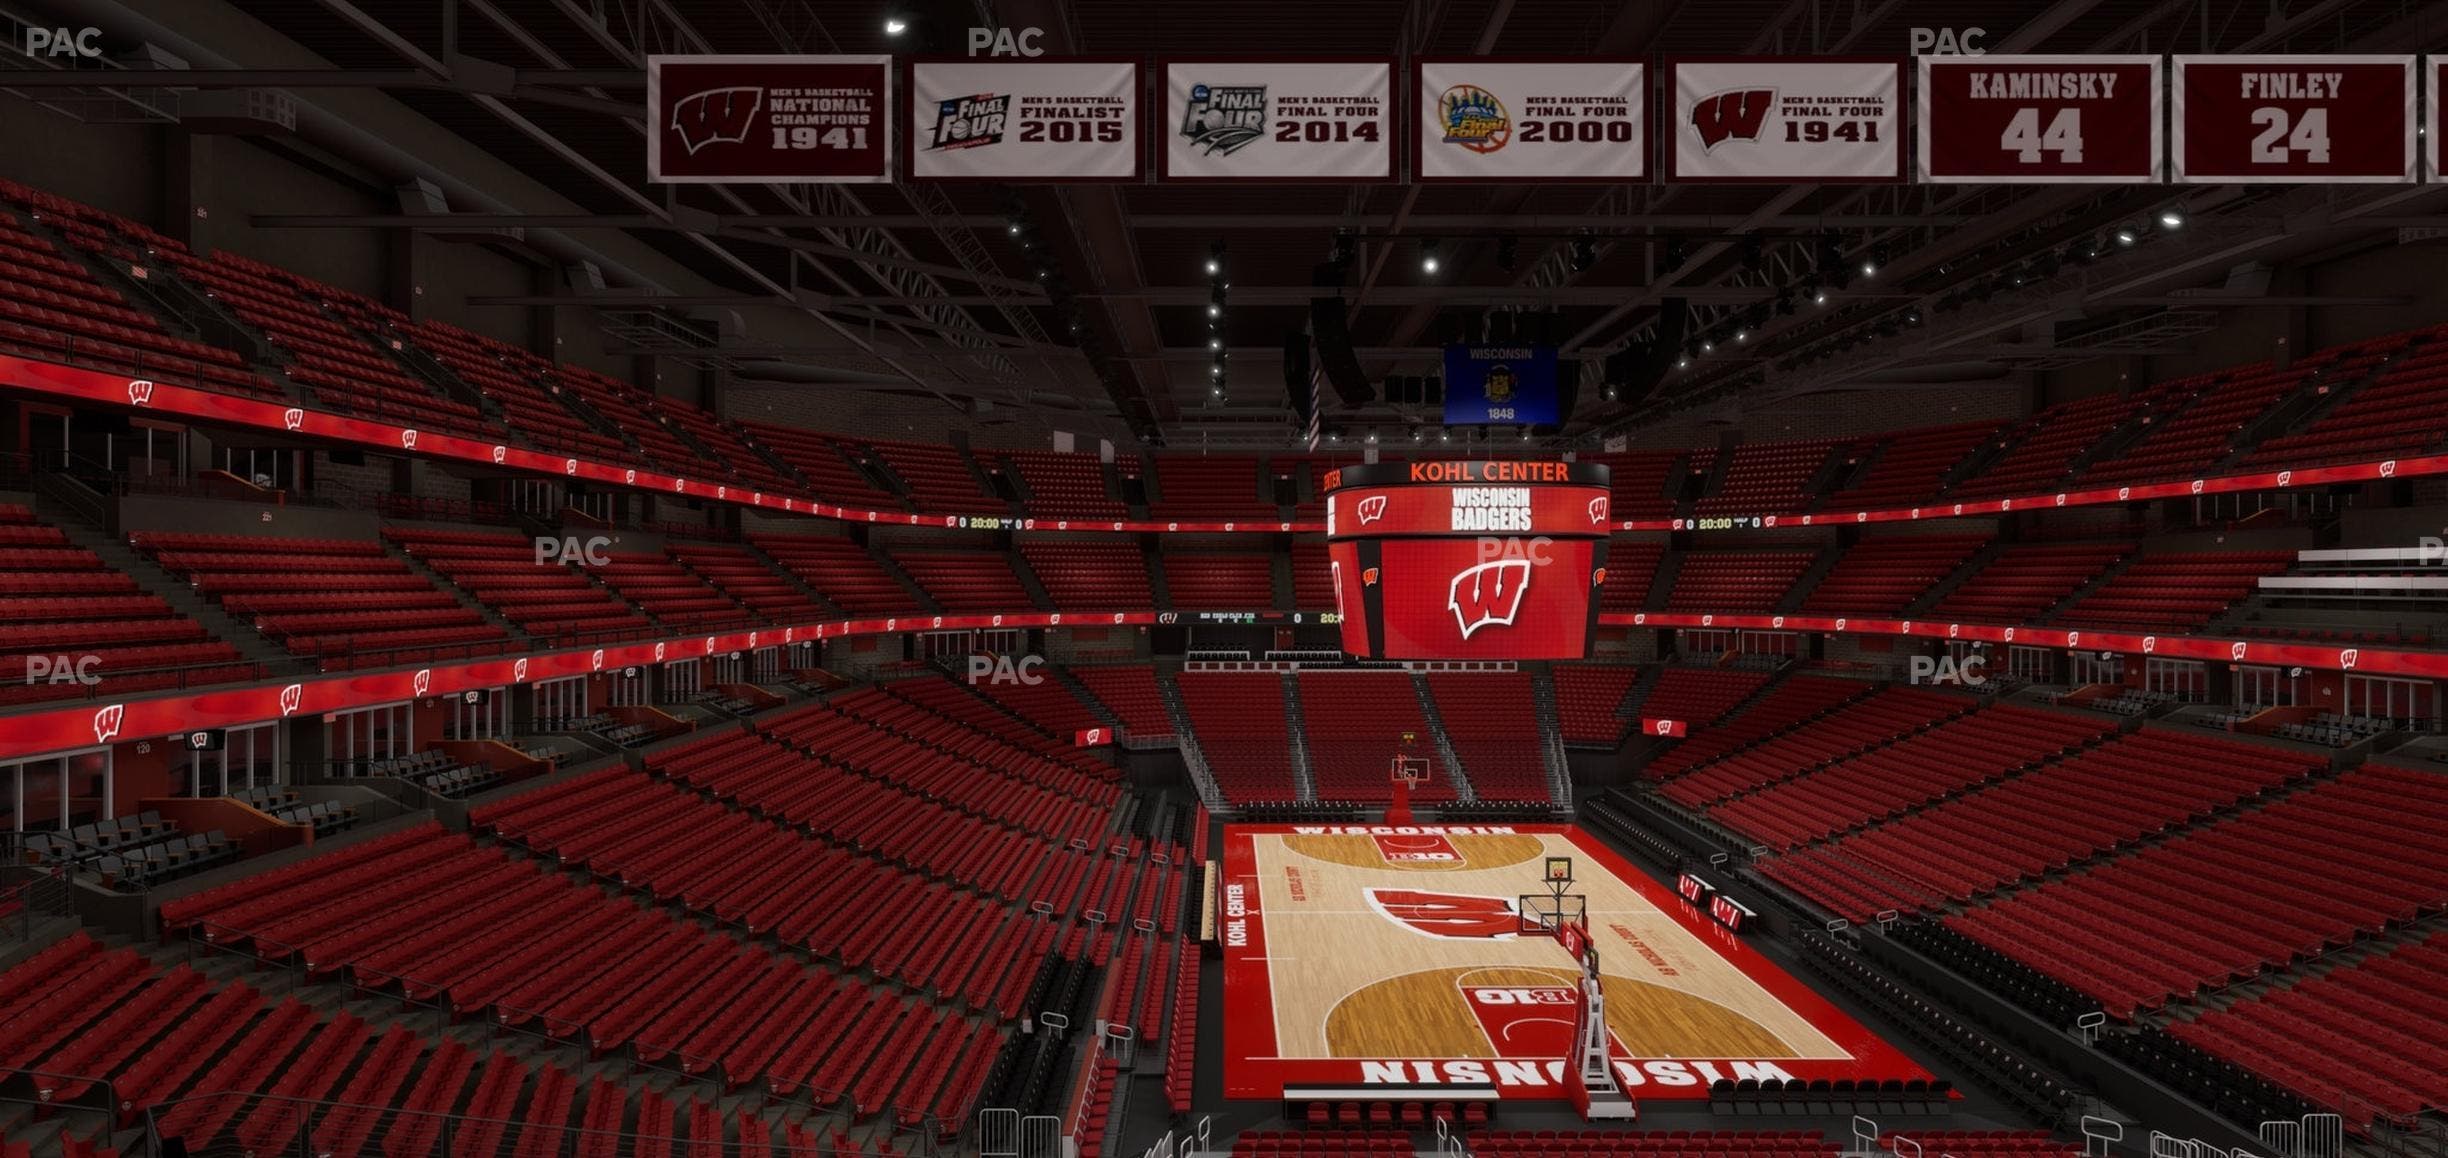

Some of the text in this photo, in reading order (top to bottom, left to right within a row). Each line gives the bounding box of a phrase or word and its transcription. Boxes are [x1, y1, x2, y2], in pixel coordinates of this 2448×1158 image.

[807, 89, 874, 97] BASKETBALL
[1969, 72, 2118, 100] KAMINSKY
[2240, 73, 2344, 100] FINLEY
[770, 98, 872, 113] NATIONAL
[1057, 97, 1124, 105] BASKETBALL
[1207, 88, 1263, 109] FINAL
[1312, 97, 1381, 105] BASKETBALL
[1560, 97, 1628, 105] BASKETBALL
[958, 98, 1004, 120] FINAL
[1021, 107, 1126, 118] FINALIST
[1277, 107, 1379, 118] FINAL FOUR
[1525, 107, 1627, 118] FINAL FOUR
[1782, 107, 1884, 117] FINAL FOUR
[770, 114, 871, 127] CHAMPIONS
[772, 127, 868, 150] 1941
[1020, 121, 1122, 143] 2015
[1275, 121, 1379, 143] 2014
[1519, 121, 1632, 143] 2000
[1785, 120, 1879, 143] 1941
[2001, 107, 2084, 164] 44
[2250, 107, 2330, 164] 24
[1470, 348, 1533, 360] WISCONSIN
[1487, 407, 1515, 420] 1848
[1410, 462, 1569, 482] KOHL CENTER
[1452, 487, 1531, 507] WISCONSIN
[959, 517, 966, 528] 0
[970, 517, 999, 529] 20:00
[1015, 519, 1022, 530] 0
[1451, 507, 1532, 531] BADGERS
[1686, 519, 1694, 530] 0
[1699, 518, 1732, 530] 20:00
[1752, 517, 1760, 528] 0
[1294, 827, 1517, 836] WISCONSIN
[1227, 884, 1247, 946] KOHL CENTER
